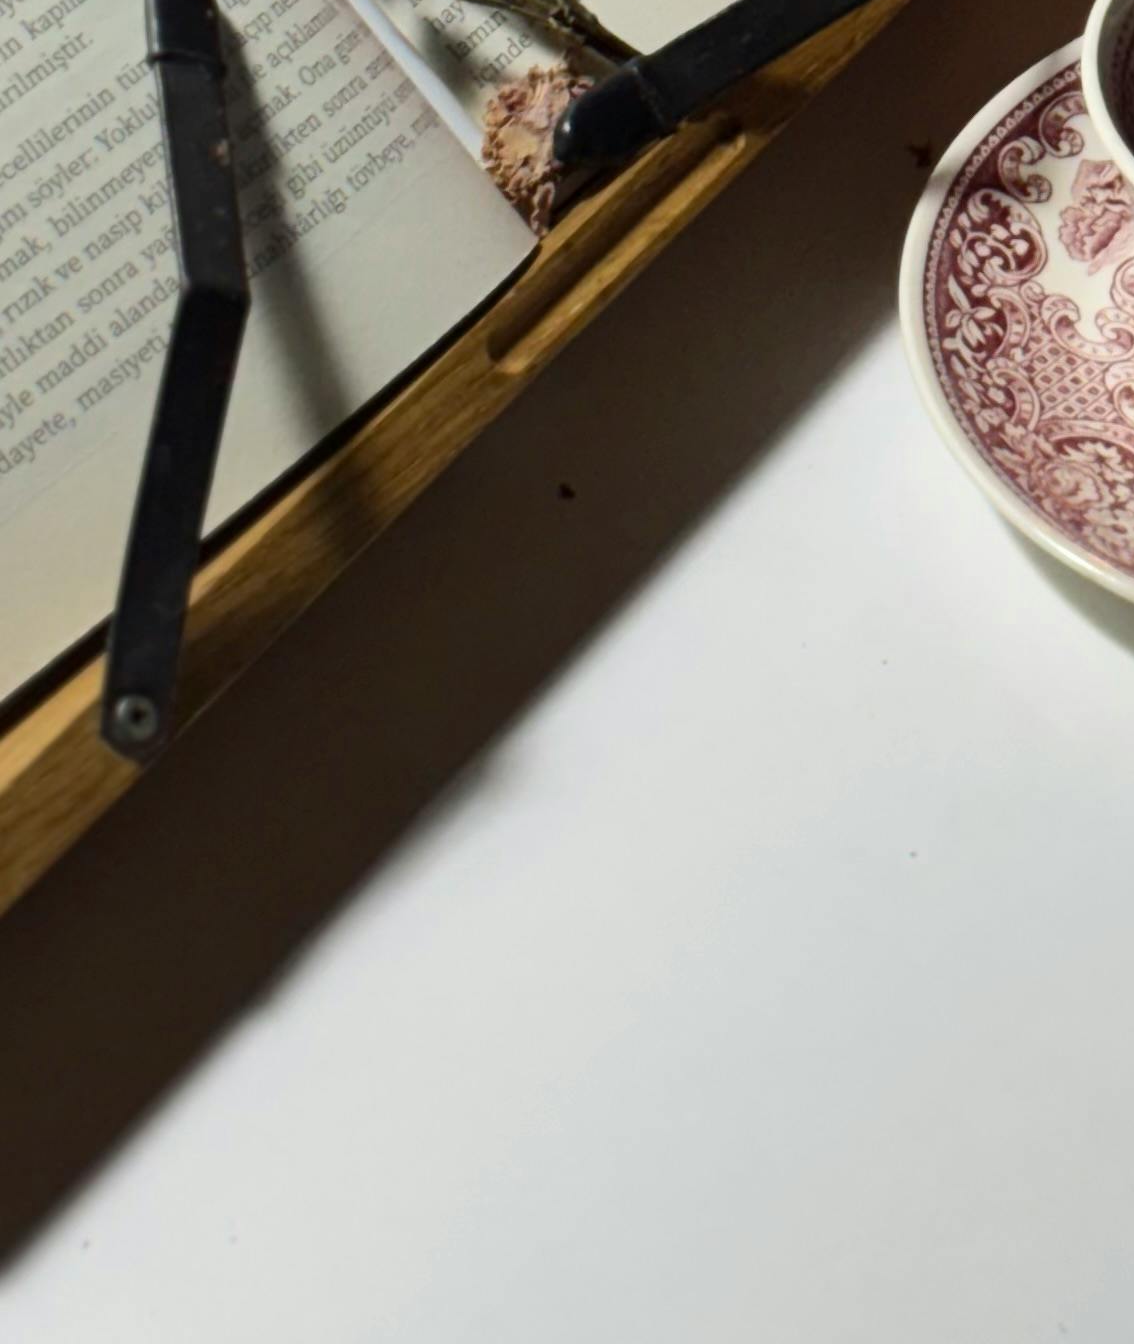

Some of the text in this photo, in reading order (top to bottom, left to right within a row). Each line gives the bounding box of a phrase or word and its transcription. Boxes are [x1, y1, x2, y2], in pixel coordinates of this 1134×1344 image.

[297, 53, 337, 87] Ona
[321, 74, 369, 118] sonra
[26, 146, 99, 209] söyler:
[285, 152, 324, 201] gibi
[345, 133, 415, 192] tövbeye,
[0, 208, 143, 325] rızık ve nasip
[75, 260, 140, 314] sonra
[34, 275, 178, 394] maddi alanda
[75, 328, 165, 412] masiyeti
